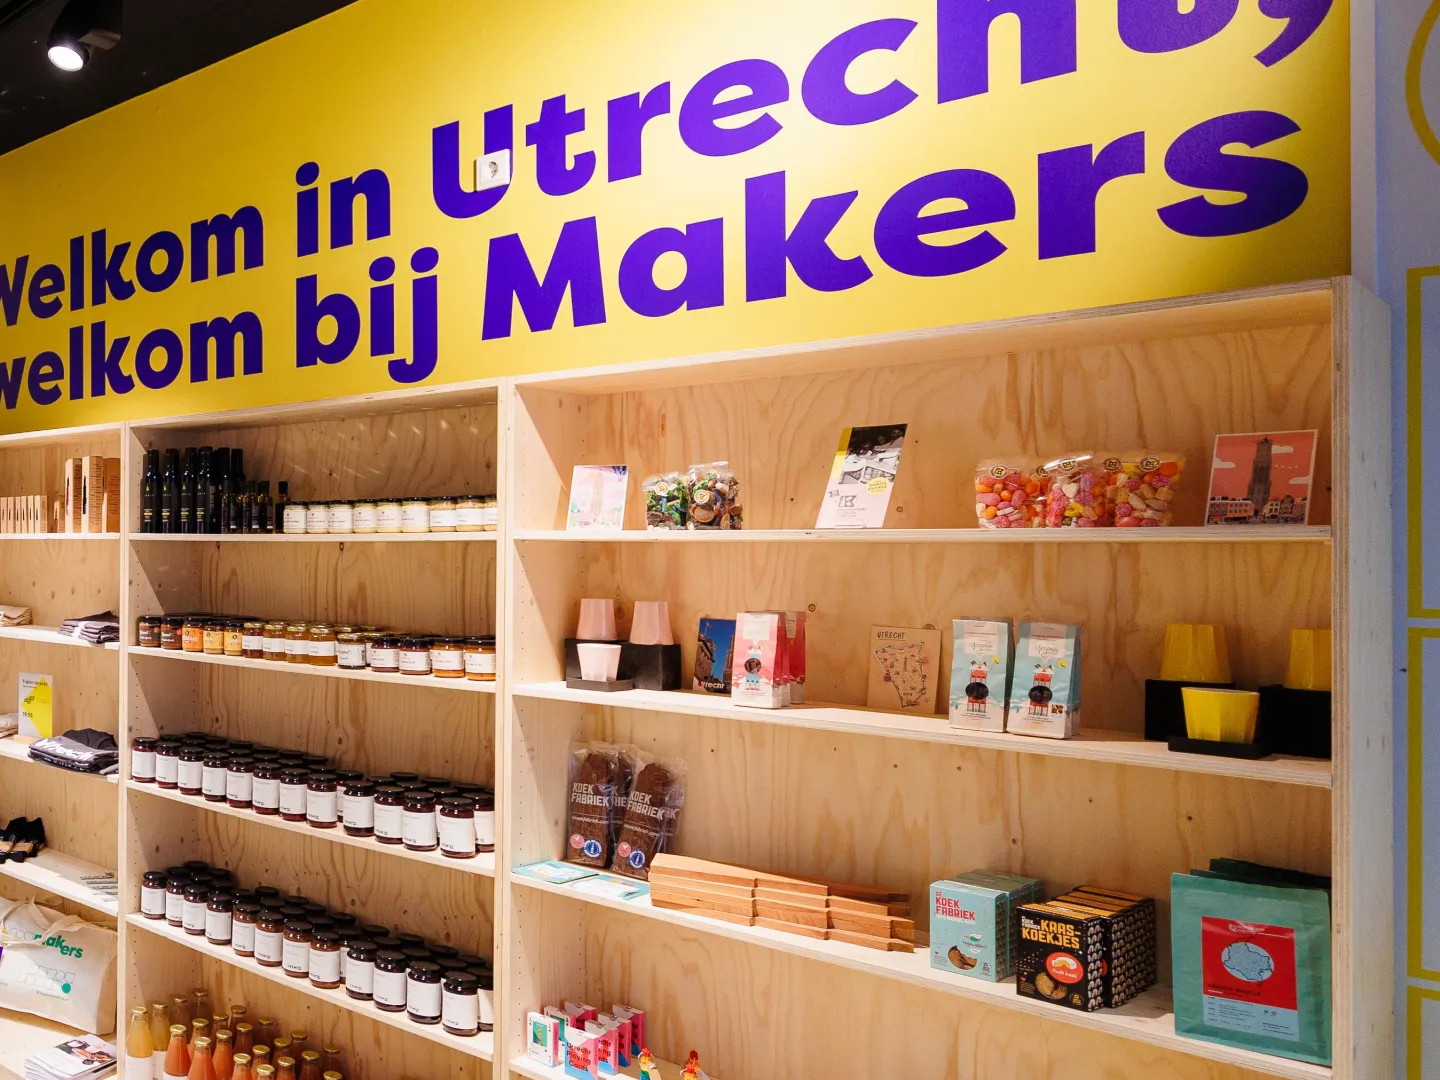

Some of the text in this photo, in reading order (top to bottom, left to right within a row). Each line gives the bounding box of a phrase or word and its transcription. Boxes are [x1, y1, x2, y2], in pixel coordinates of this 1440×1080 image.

[294, 161, 391, 258] in
[295, 247, 440, 385] bij
[481, 110, 1309, 342] Makers
[572, 782, 594, 794] KOEK
[571, 792, 610, 806] FABRIEK
[629, 790, 652, 804] KOEK
[626, 800, 666, 820] FABRIEK
[936, 896, 960, 908] KOEK
[936, 906, 976, 920] FABRIEK
[1040, 920, 1081, 936] KAAS-
[1022, 928, 1080, 949] KOEKJES
[566, 1050, 591, 1066] Playing
[568, 1060, 588, 1072] Cards
